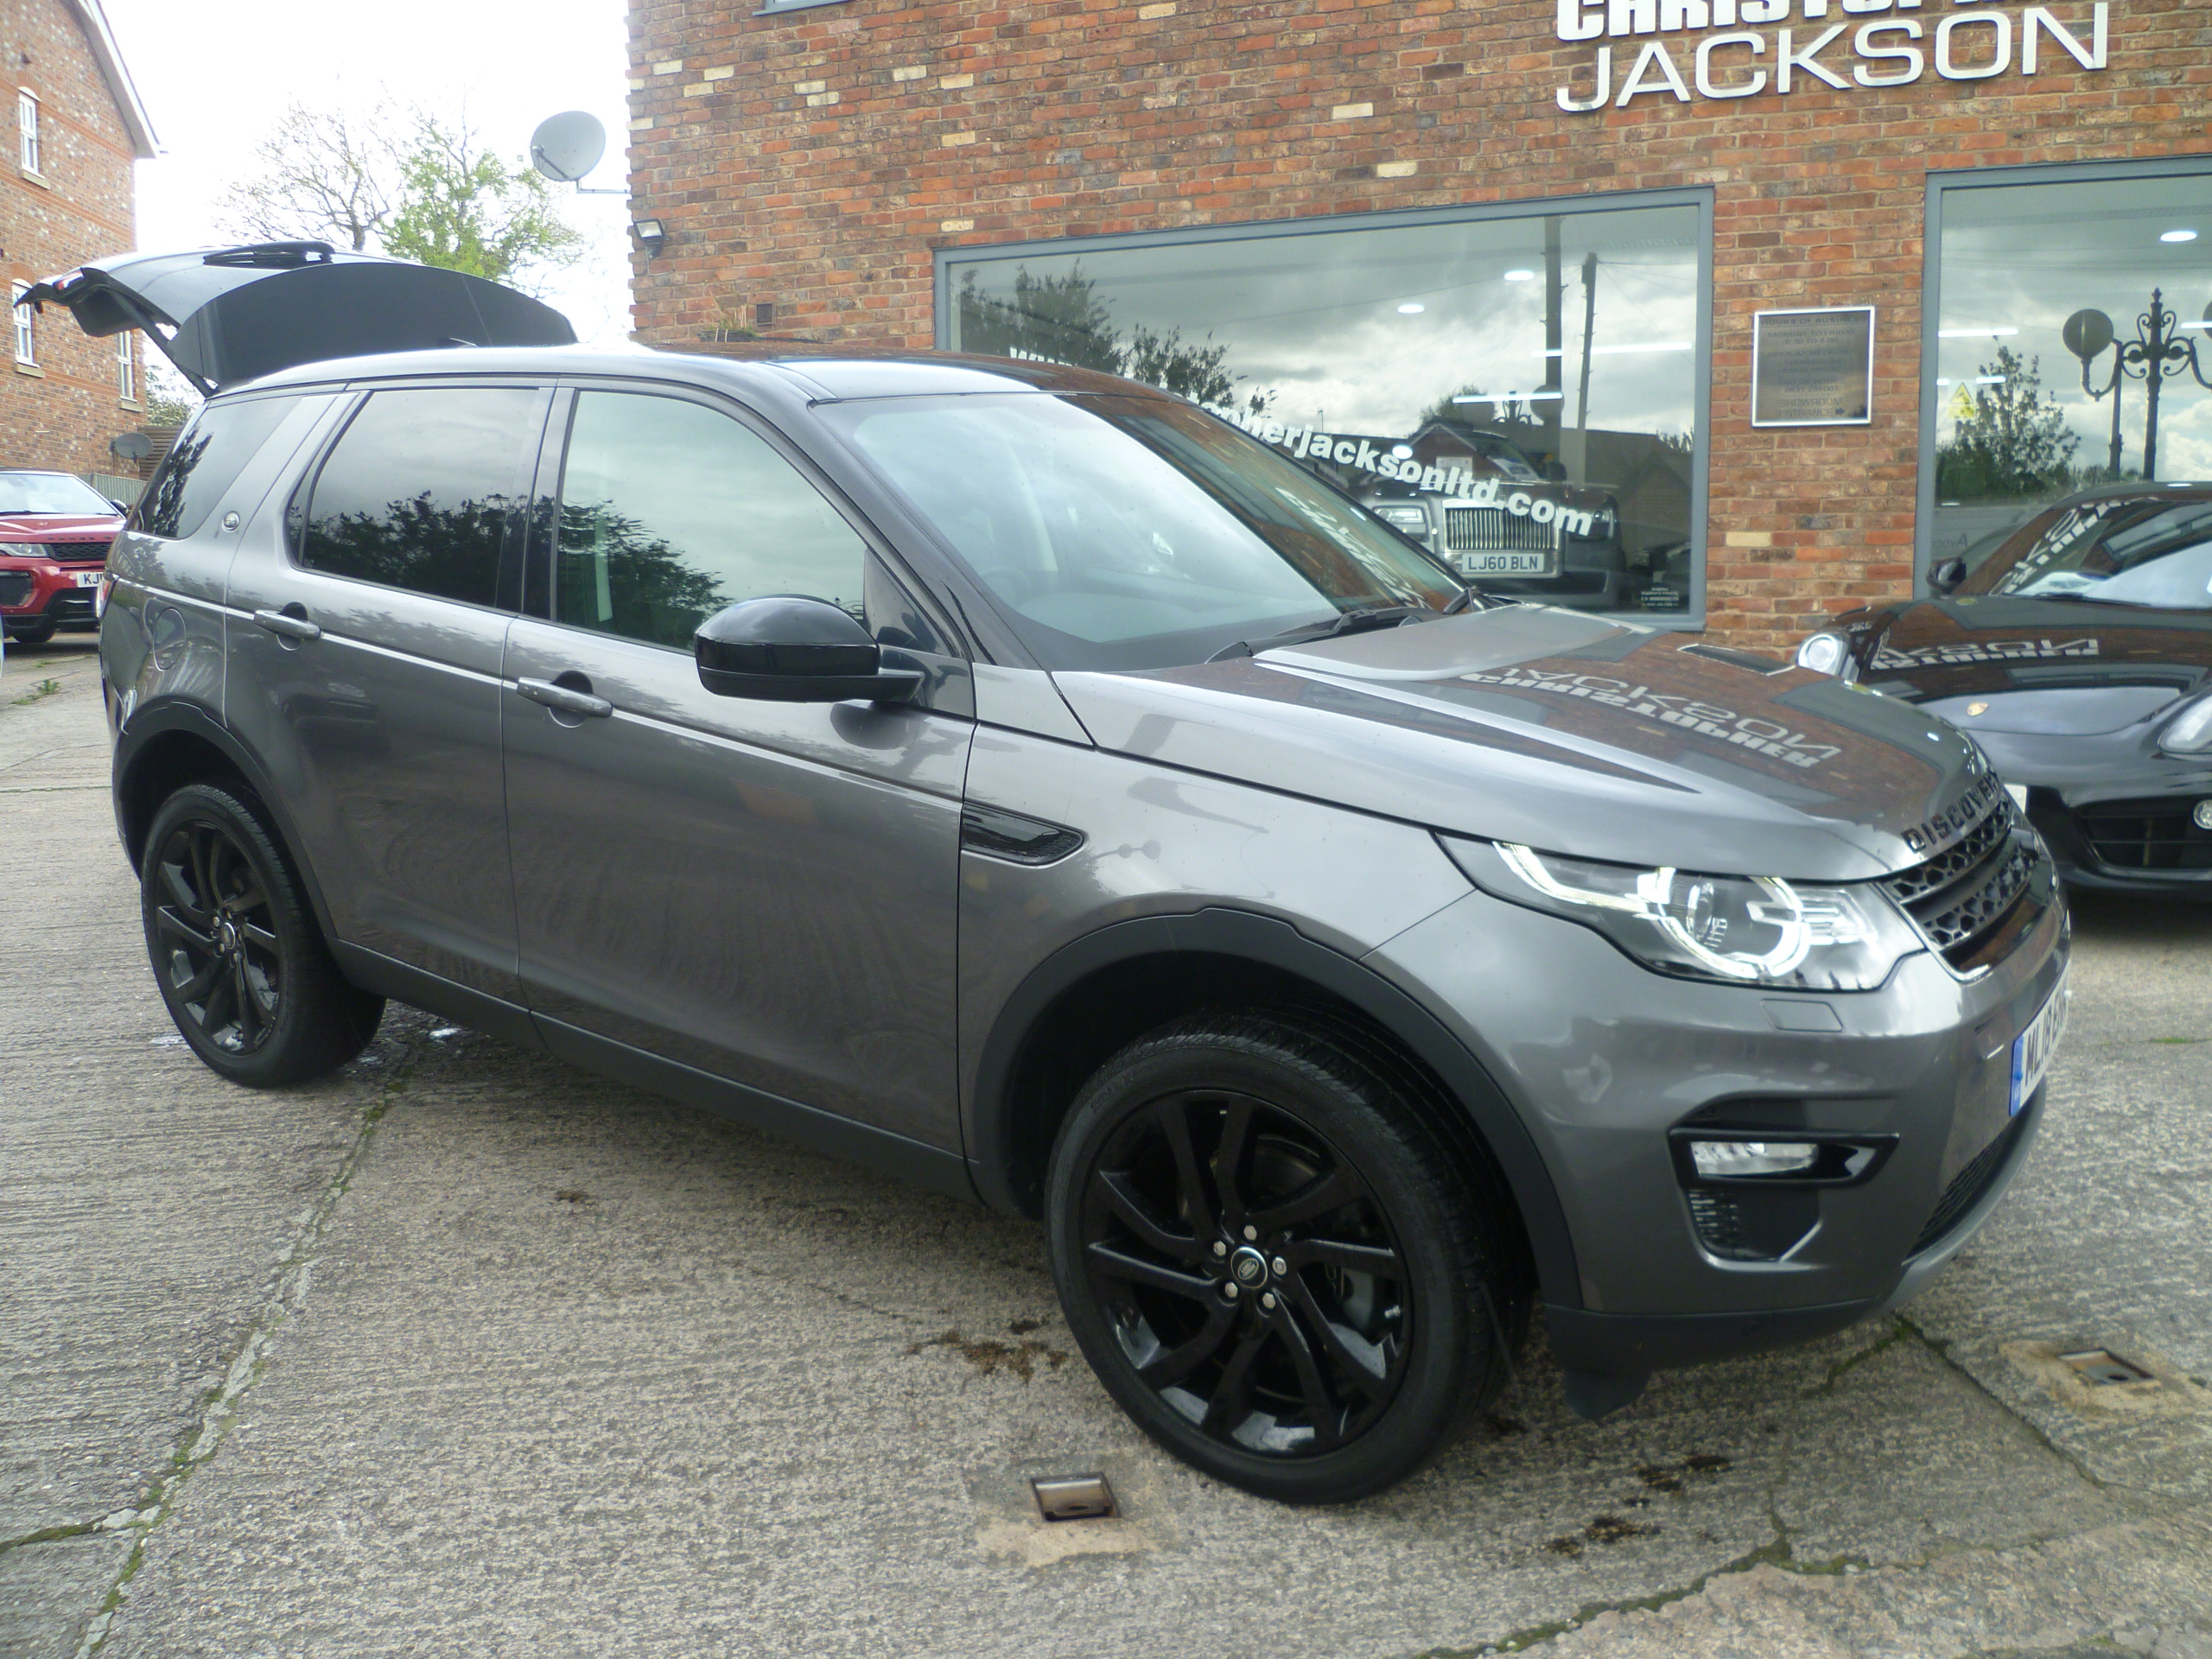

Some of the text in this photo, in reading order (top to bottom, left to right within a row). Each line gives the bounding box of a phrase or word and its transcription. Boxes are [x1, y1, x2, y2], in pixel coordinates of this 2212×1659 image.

[1556, 2, 2108, 112] JACKSON
[1778, 397, 1843, 408] SHOWROOM
[1468, 556, 1538, 570] LJ60 BLN
[83, 573, 104, 585] KJ
